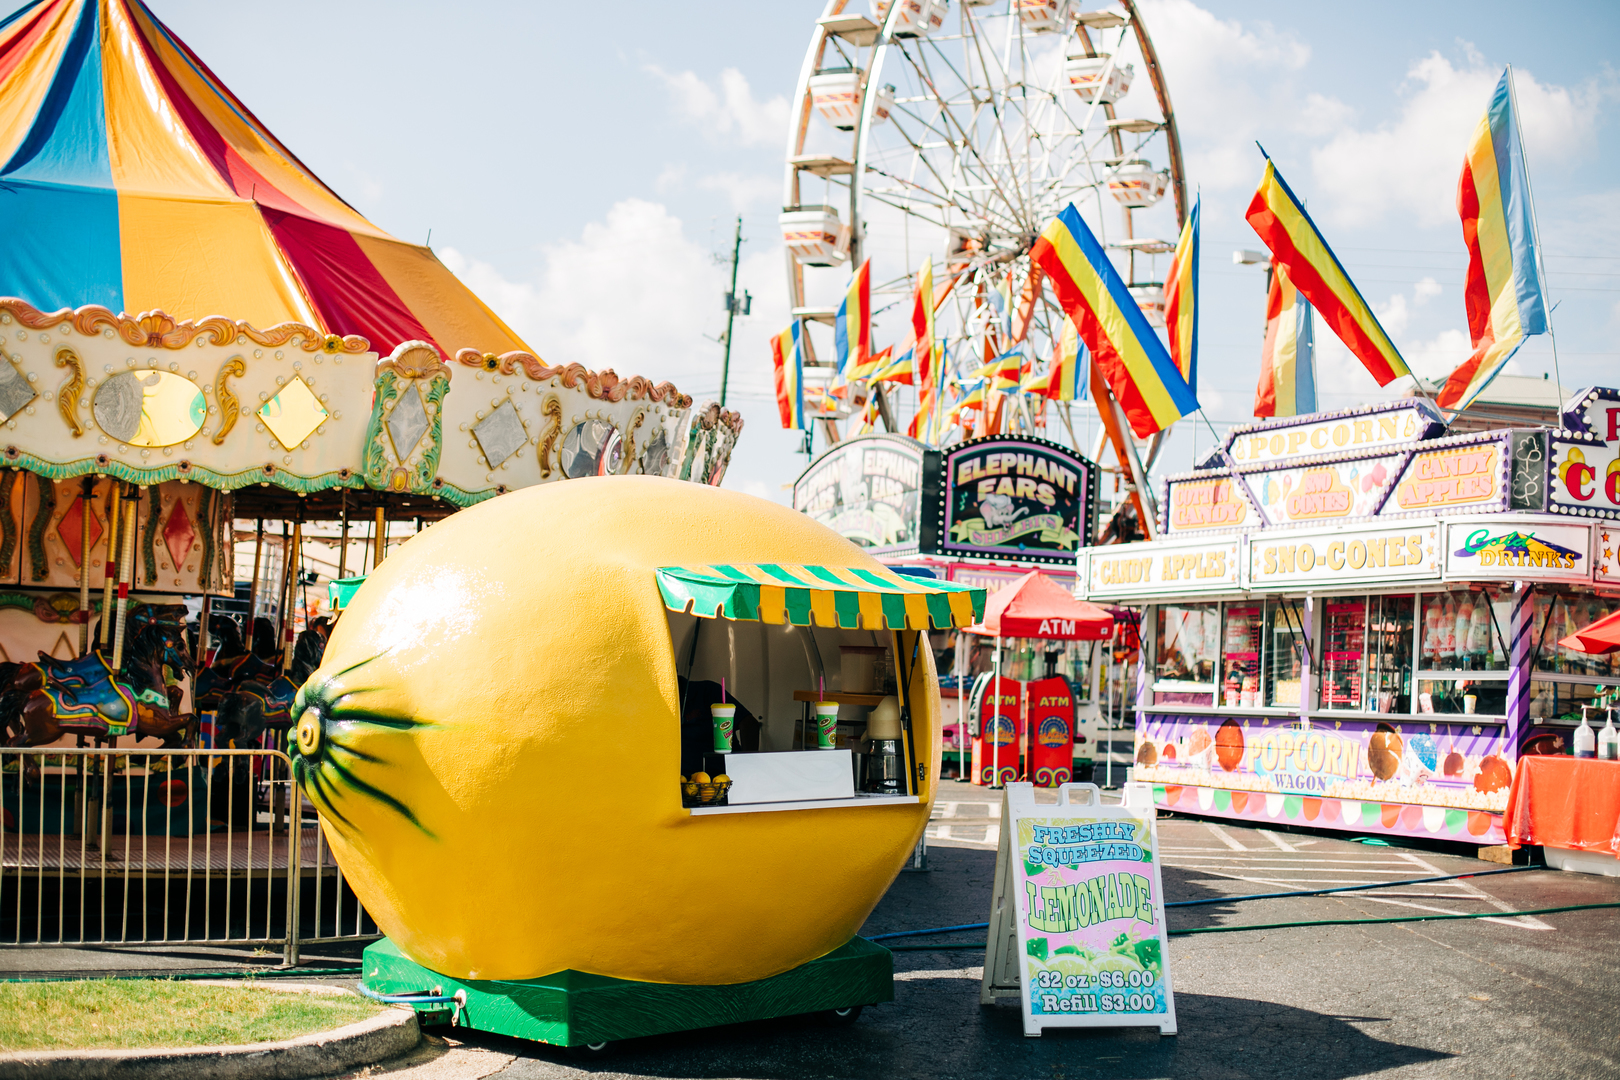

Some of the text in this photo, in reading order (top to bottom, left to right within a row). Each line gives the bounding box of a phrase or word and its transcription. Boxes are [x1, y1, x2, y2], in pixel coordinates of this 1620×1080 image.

[1249, 415, 1399, 459] POPCORN
[863, 449, 919, 489] ELEPHANT
[957, 453, 1077, 495] ELEPHANT
[1415, 451, 1492, 480] CANDY
[871, 475, 904, 508] EARS
[977, 477, 1056, 506] EARS
[1174, 484, 1231, 506] COTTON
[1305, 472, 1333, 494] SNO
[1400, 475, 1492, 505] APPLES
[1174, 503, 1242, 526] CANDY
[1288, 491, 1349, 515] CONES
[972, 516, 1057, 544] SHELBI'S
[1465, 529, 1535, 553] Cold
[1263, 535, 1423, 574] SNO-CONES
[1480, 550, 1575, 569] DRINKS
[1100, 551, 1226, 585] CANDY APPLES
[1038, 619, 1076, 635] ATM
[1039, 696, 1069, 707] ATM
[1246, 733, 1361, 780] POPCORN
[1274, 773, 1328, 792] WAGON
[1032, 822, 1136, 845] FRESHLY
[1028, 843, 1144, 868] SQUEEZED
[1025, 872, 1154, 933] LEMONADE
[1038, 971, 1063, 988] 32
[1065, 974, 1090, 988] oz
[1100, 970, 1154, 988] $6.00
[1042, 994, 1155, 1012] Refill $3.00
